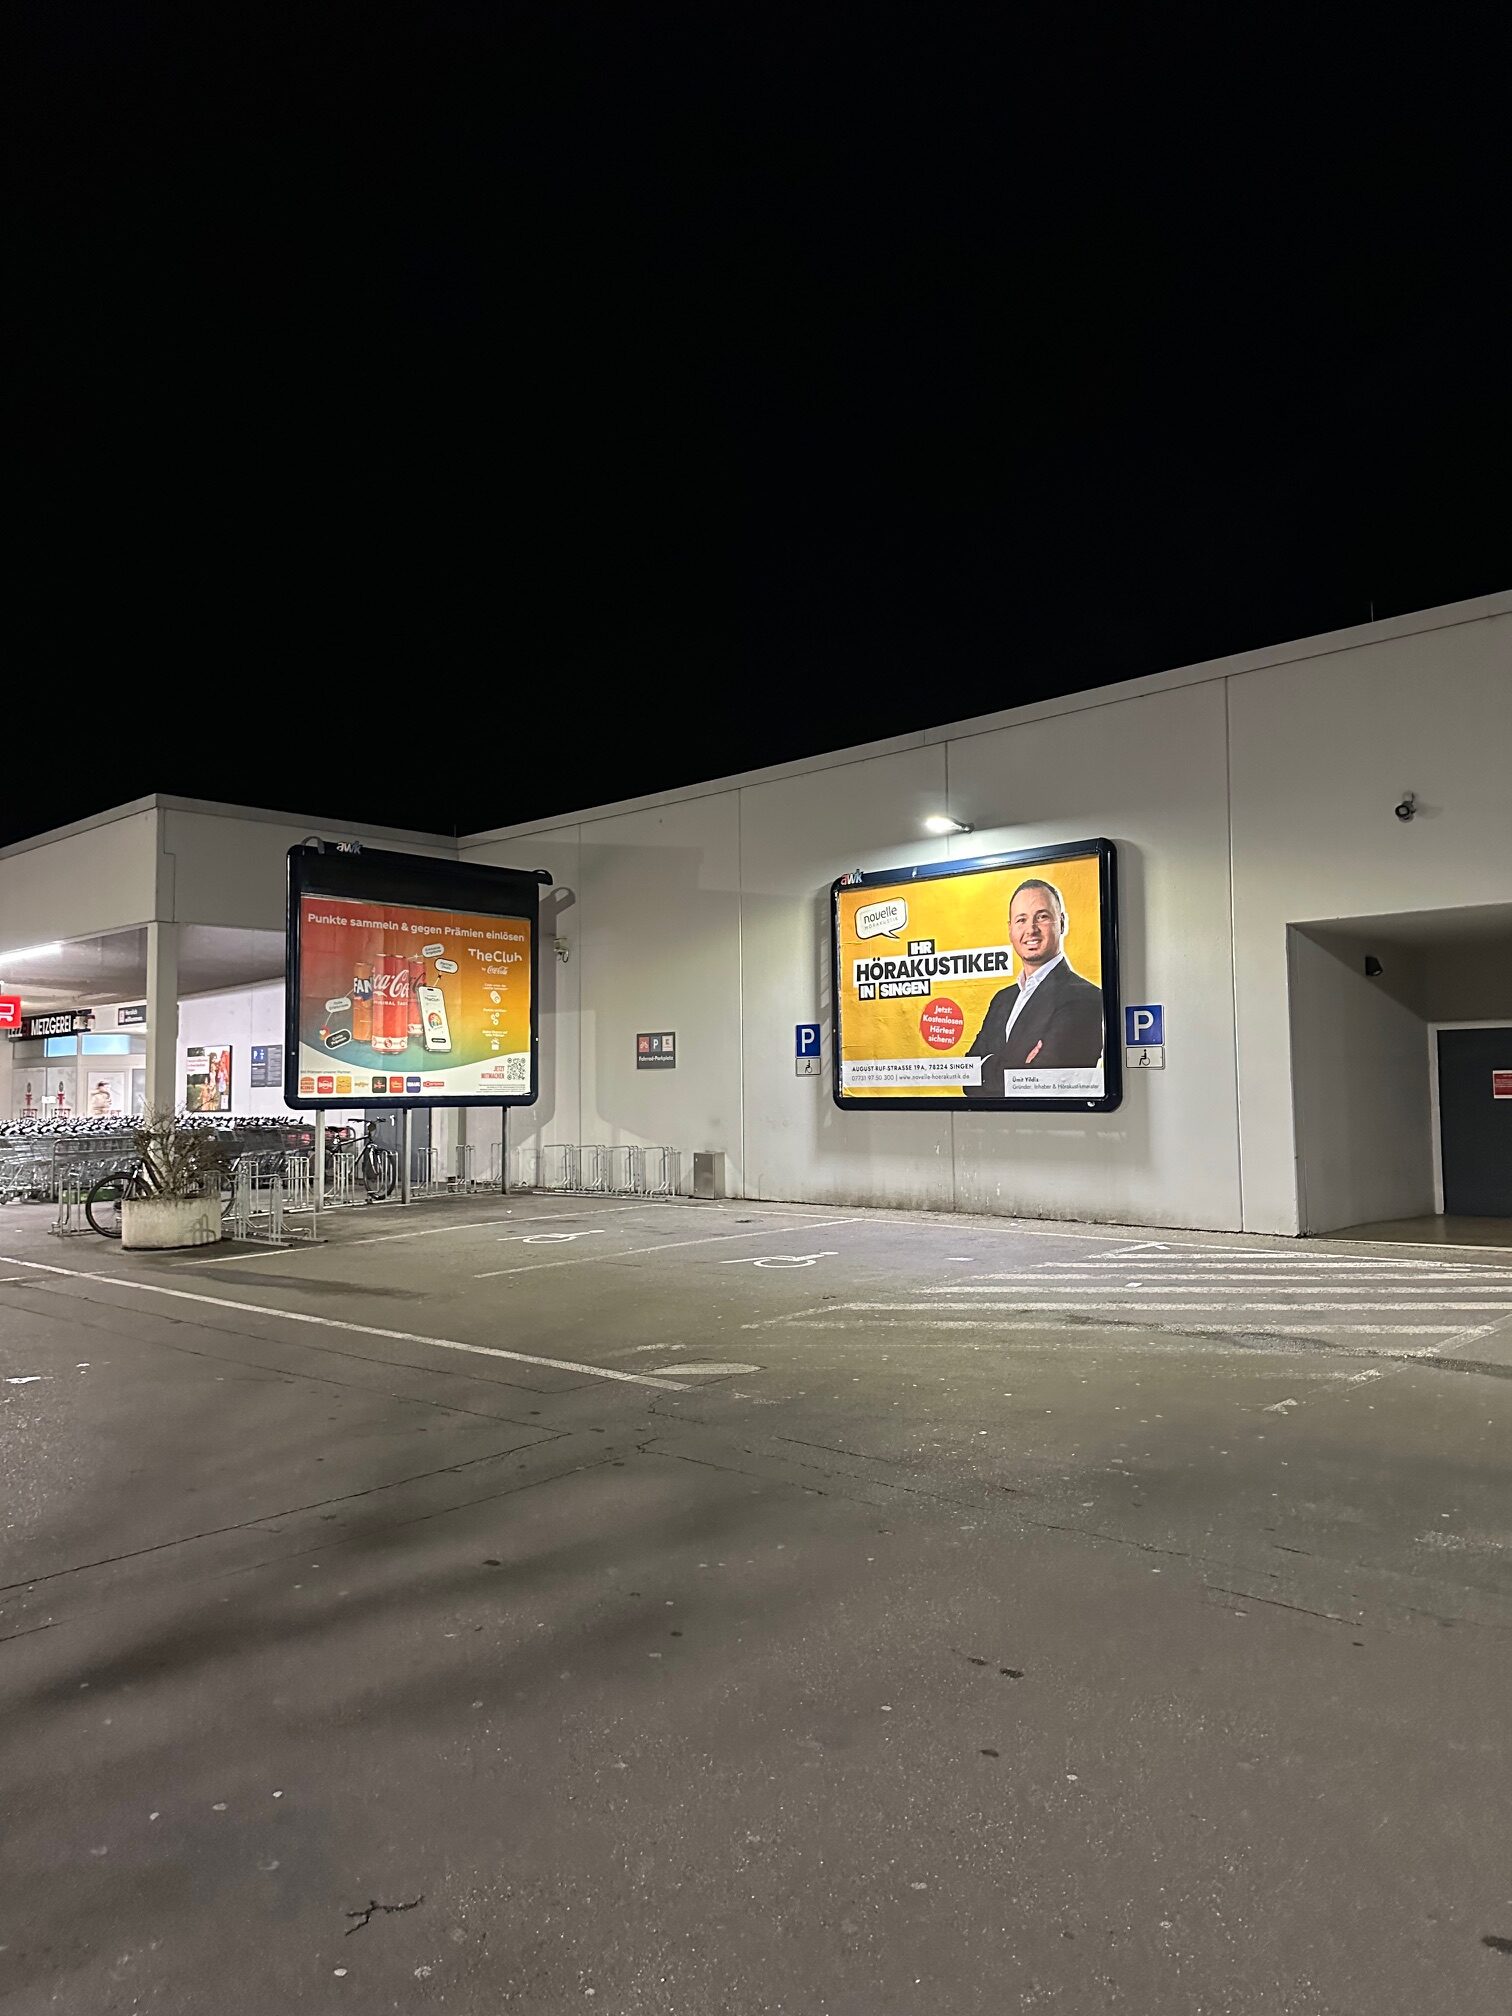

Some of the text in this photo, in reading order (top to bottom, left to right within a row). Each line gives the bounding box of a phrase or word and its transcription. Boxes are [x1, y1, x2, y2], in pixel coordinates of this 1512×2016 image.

[840, 869, 864, 886] awk
[307, 913, 525, 942] Punkte sammeln & gegen Prämien einlösen
[910, 941, 932, 955] IHR
[856, 951, 1009, 982] HÖRAKUSTIKER
[860, 980, 929, 999] IN SINGEN
[934, 1005, 953, 1014] Jetzt:
[31, 1015, 72, 1036] METZGEREI
[922, 1014, 963, 1026] Kostenlosen
[1133, 1010, 1154, 1041] P
[929, 1026, 955, 1035] Hörtest
[653, 1038, 659, 1049] P
[801, 1028, 815, 1054] P
[928, 1035, 955, 1044] sichern!
[913, 1064, 927, 1072] 19A,
